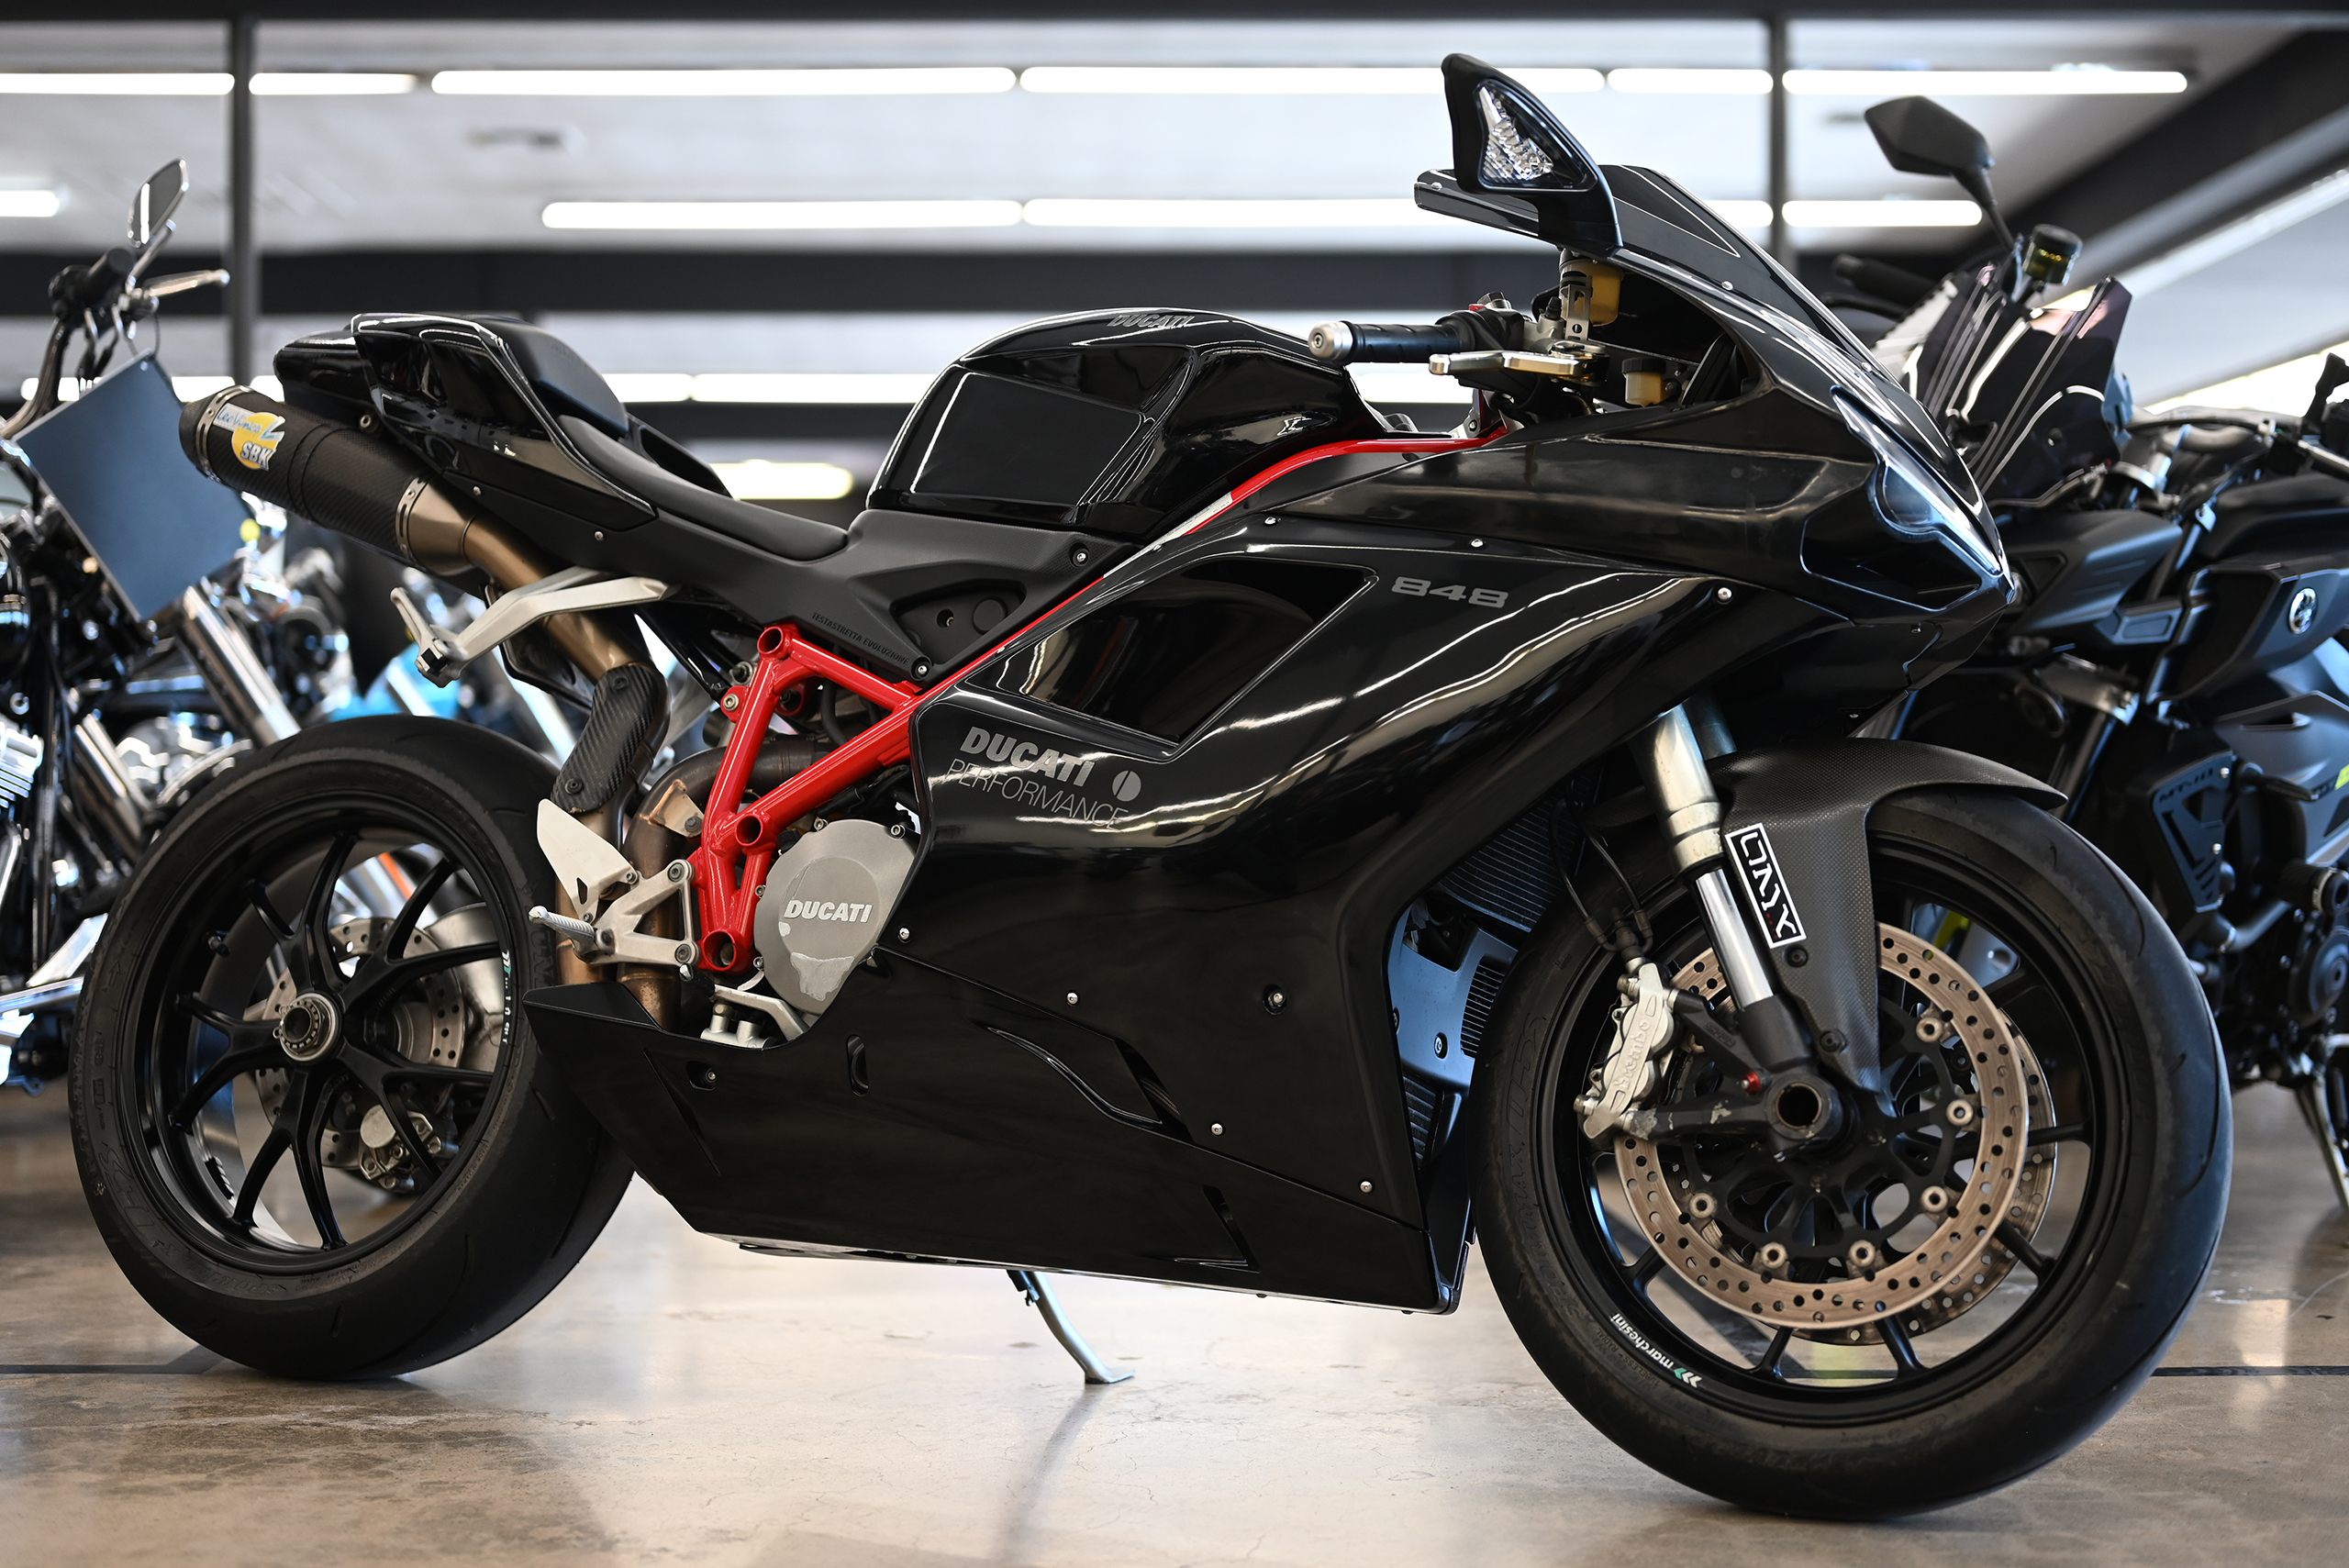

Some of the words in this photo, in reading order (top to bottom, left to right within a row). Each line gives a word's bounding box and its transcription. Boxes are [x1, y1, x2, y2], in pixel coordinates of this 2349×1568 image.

[1107, 315, 1195, 328] DUCATI
[240, 440, 273, 470] SBK
[1391, 576, 1509, 608] 848
[811, 612, 863, 641] TESTASTRETTA
[863, 638, 910, 665] EVOLUZIONE
[960, 727, 1095, 786] DUCATI
[944, 759, 1129, 831] PERFORMANCE
[784, 900, 873, 923] DUCATI
[1613, 1018, 1651, 1090] brembo
[1610, 1313, 1675, 1369] marchesini
